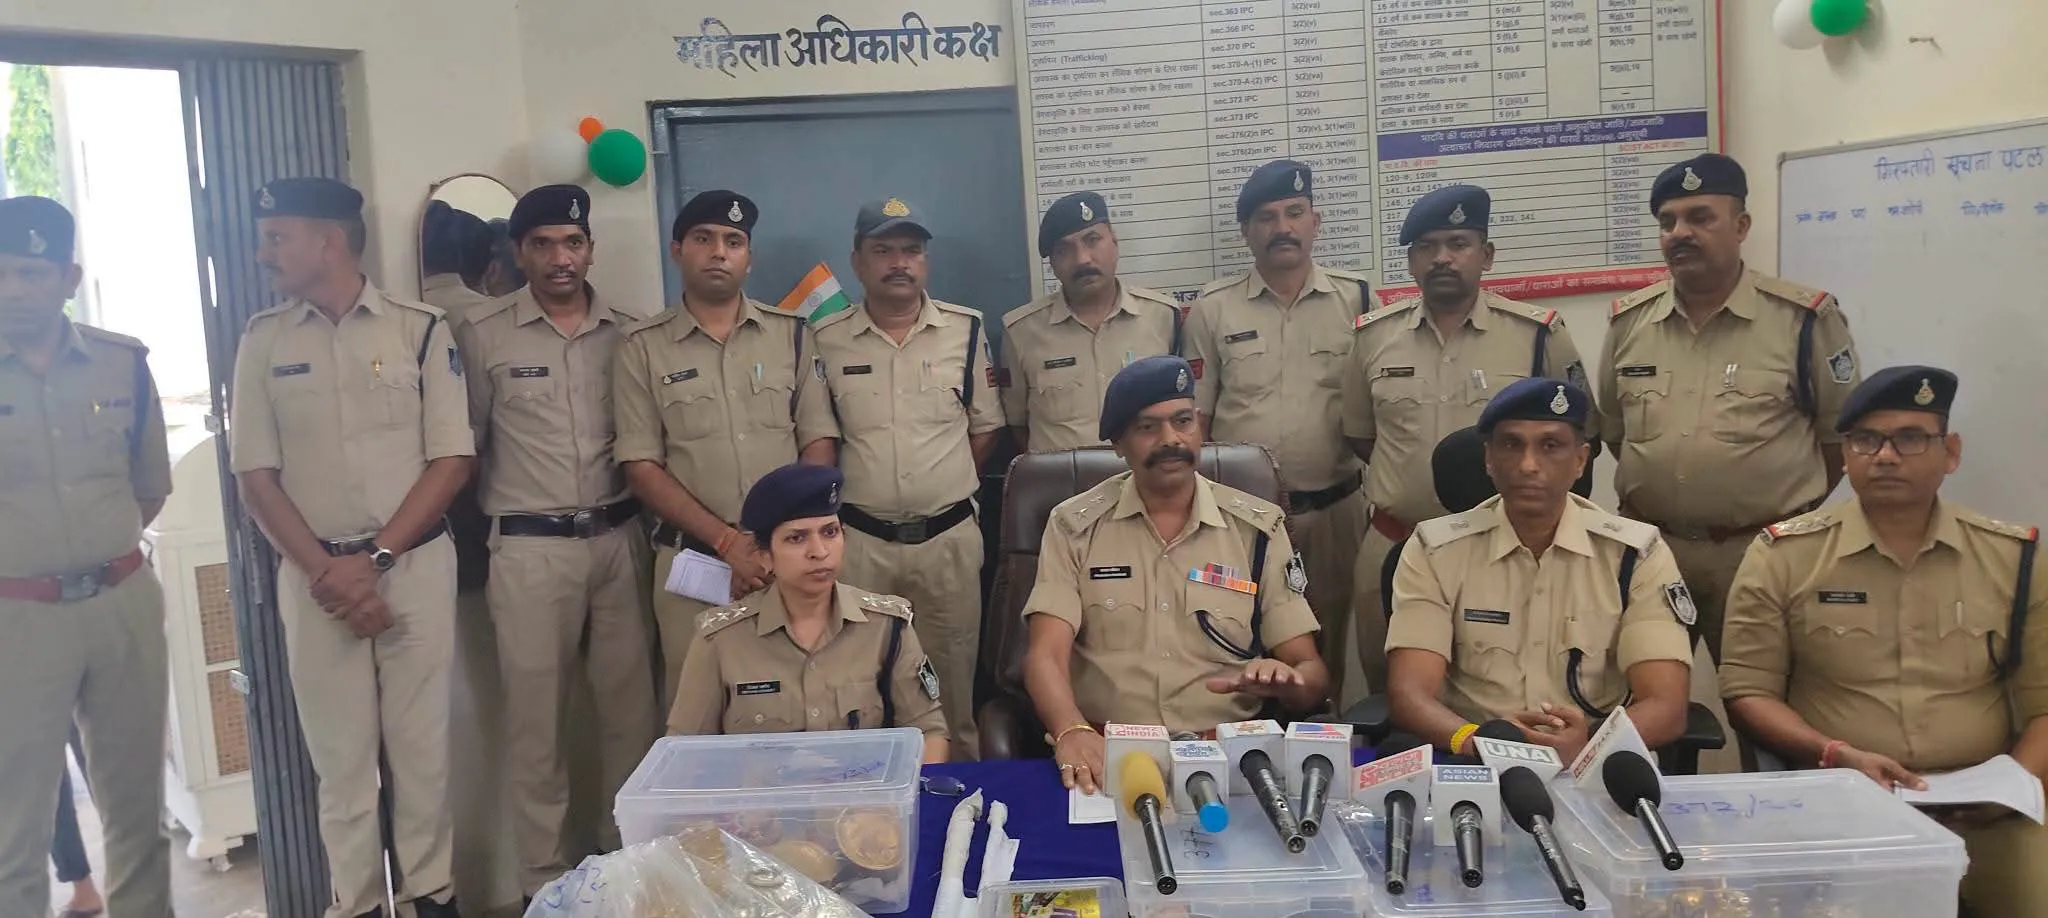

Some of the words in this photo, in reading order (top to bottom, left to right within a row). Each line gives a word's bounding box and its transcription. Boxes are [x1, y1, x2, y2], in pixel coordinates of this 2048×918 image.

[673, 16, 782, 79] महिला
[784, 11, 931, 67] अधिकारी
[933, 21, 1003, 63] कक्ष
[1264, 58, 1277, 66] IPC
[1261, 129, 1274, 137] IPC
[1264, 146, 1277, 154] IPC
[1999, 146, 2046, 172] पटल
[1485, 741, 1554, 763] UNA
